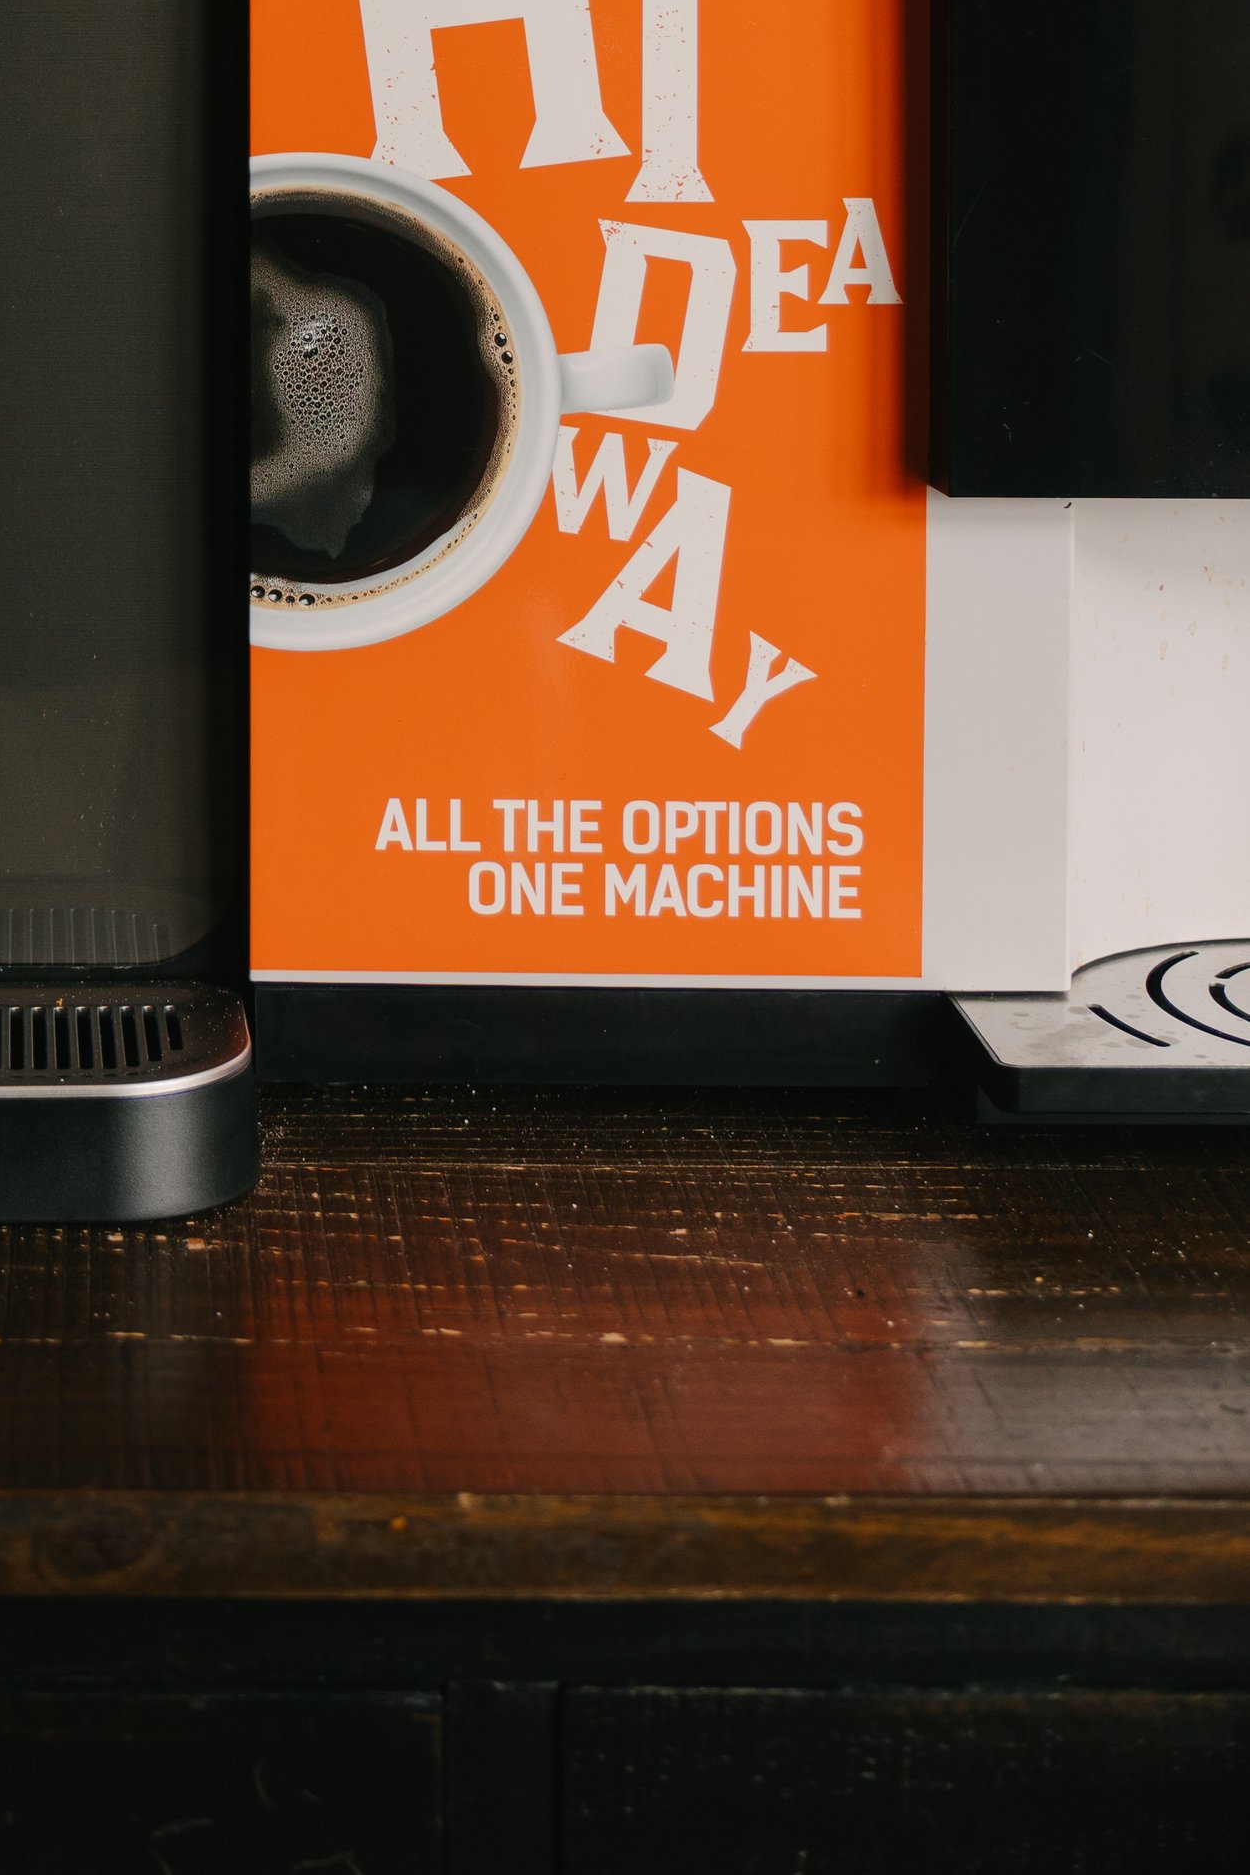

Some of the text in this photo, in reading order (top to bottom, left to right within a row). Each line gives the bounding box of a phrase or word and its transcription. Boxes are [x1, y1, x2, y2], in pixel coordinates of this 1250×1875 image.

[374, 797, 864, 856] ALL THE OPTIONS
[467, 861, 862, 920] ONE MACHINE
